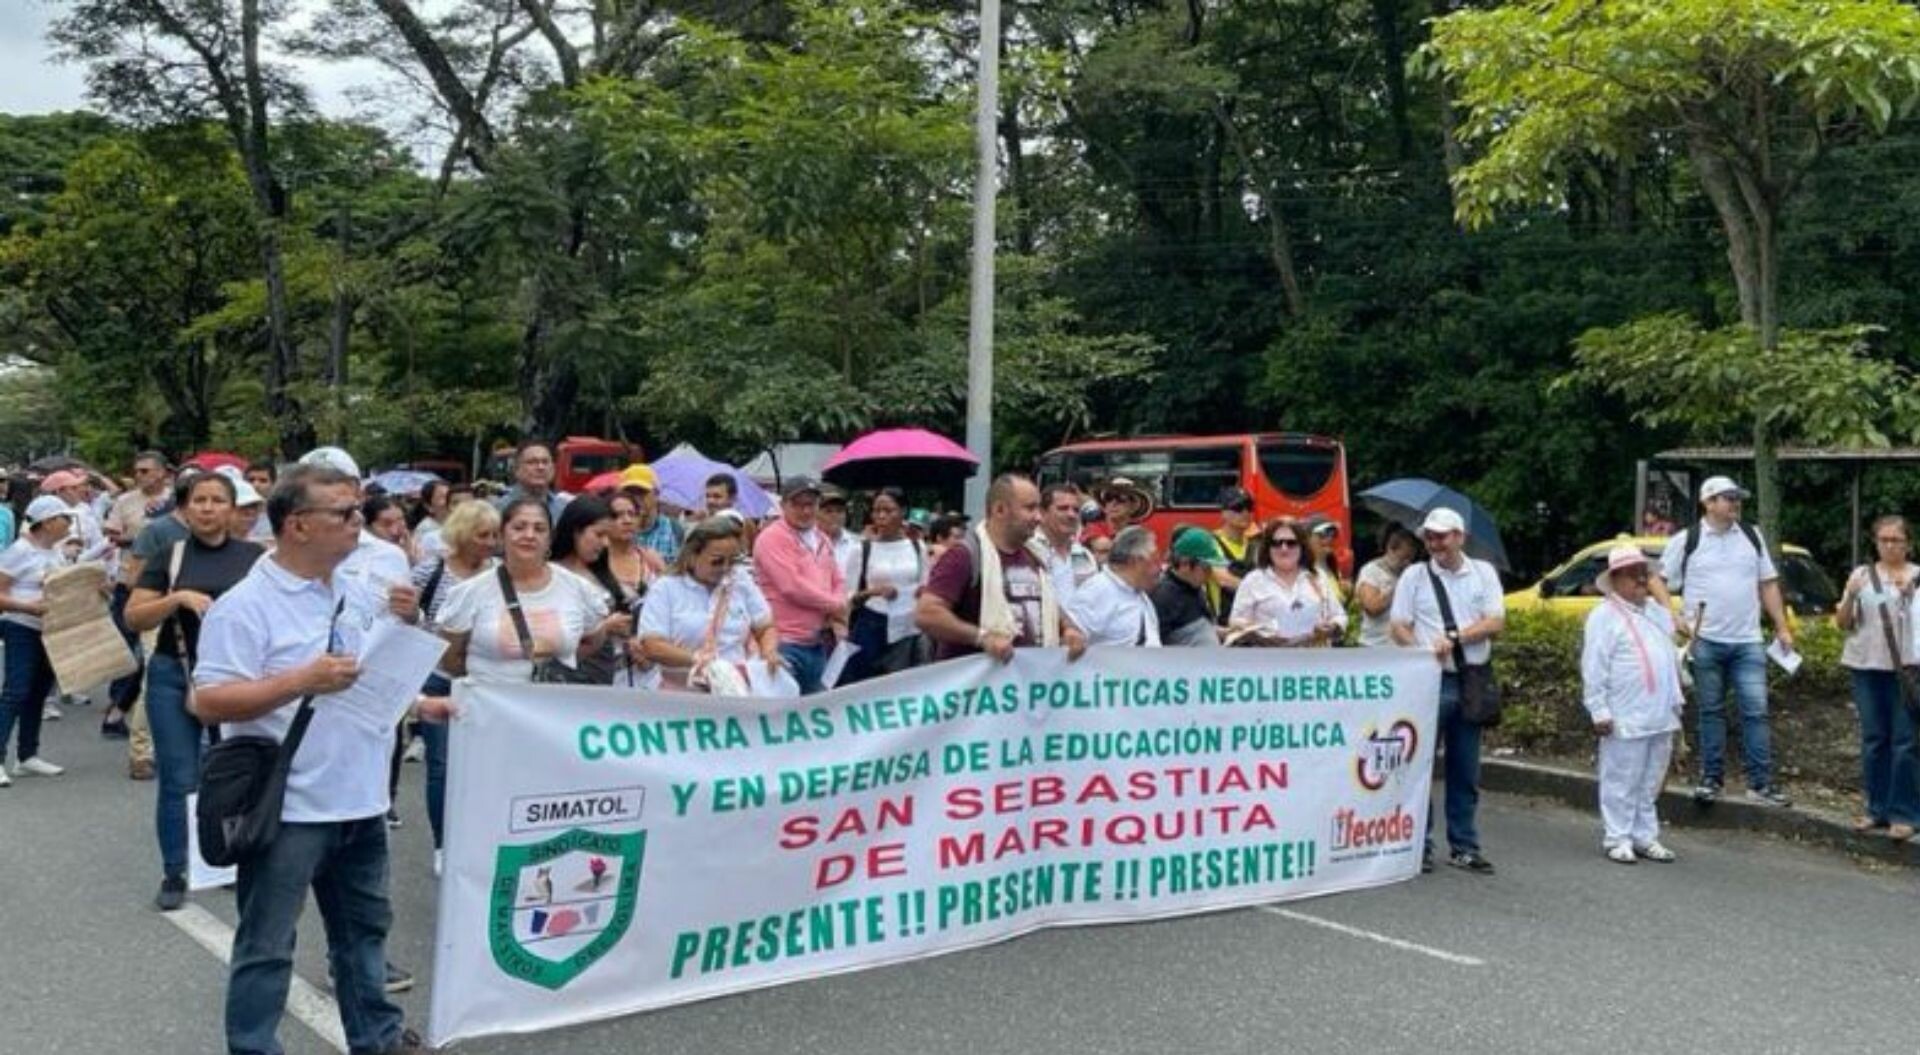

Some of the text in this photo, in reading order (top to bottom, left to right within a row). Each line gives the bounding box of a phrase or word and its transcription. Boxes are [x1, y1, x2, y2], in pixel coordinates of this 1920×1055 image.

[577, 674, 1394, 762] CONTRA LAS NEFASTAS POLÍTICAS NEOLIBERALES
[526, 797, 628, 823] SIMATOL
[670, 717, 1346, 816] Y EN DEFENSA DE LA EDUCACIÓN PÚBLICA
[780, 761, 1289, 850] SAN SEBASTIAN
[529, 833, 621, 861] SINDICATO
[815, 804, 1276, 890] DE MARIQUITA
[670, 898, 886, 980] PRESENTE
[938, 862, 1103, 929] PRESENTE
